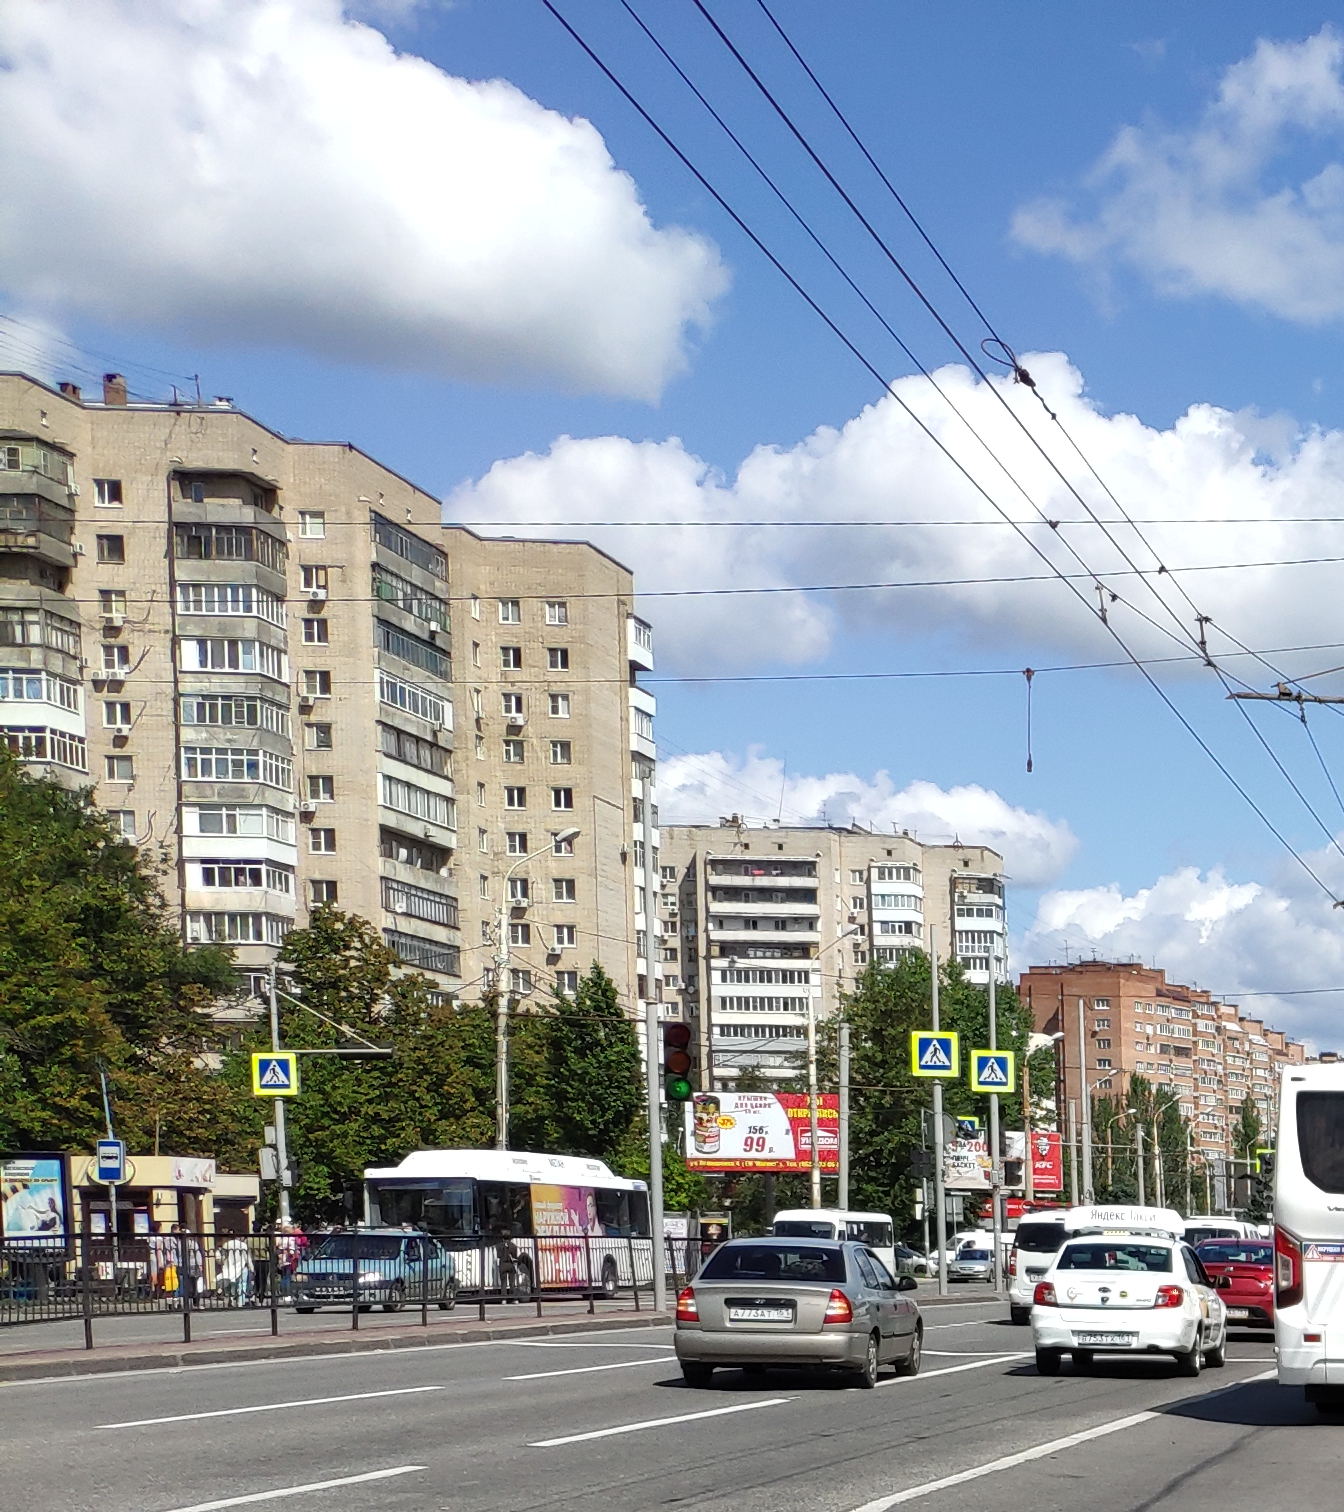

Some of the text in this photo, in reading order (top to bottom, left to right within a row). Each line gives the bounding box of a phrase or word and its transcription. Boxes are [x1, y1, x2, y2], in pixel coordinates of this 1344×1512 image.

[748, 1126, 764, 1135] 156
[742, 1136, 766, 1153] 99
[1091, 1209, 1125, 1222] Яндекс
